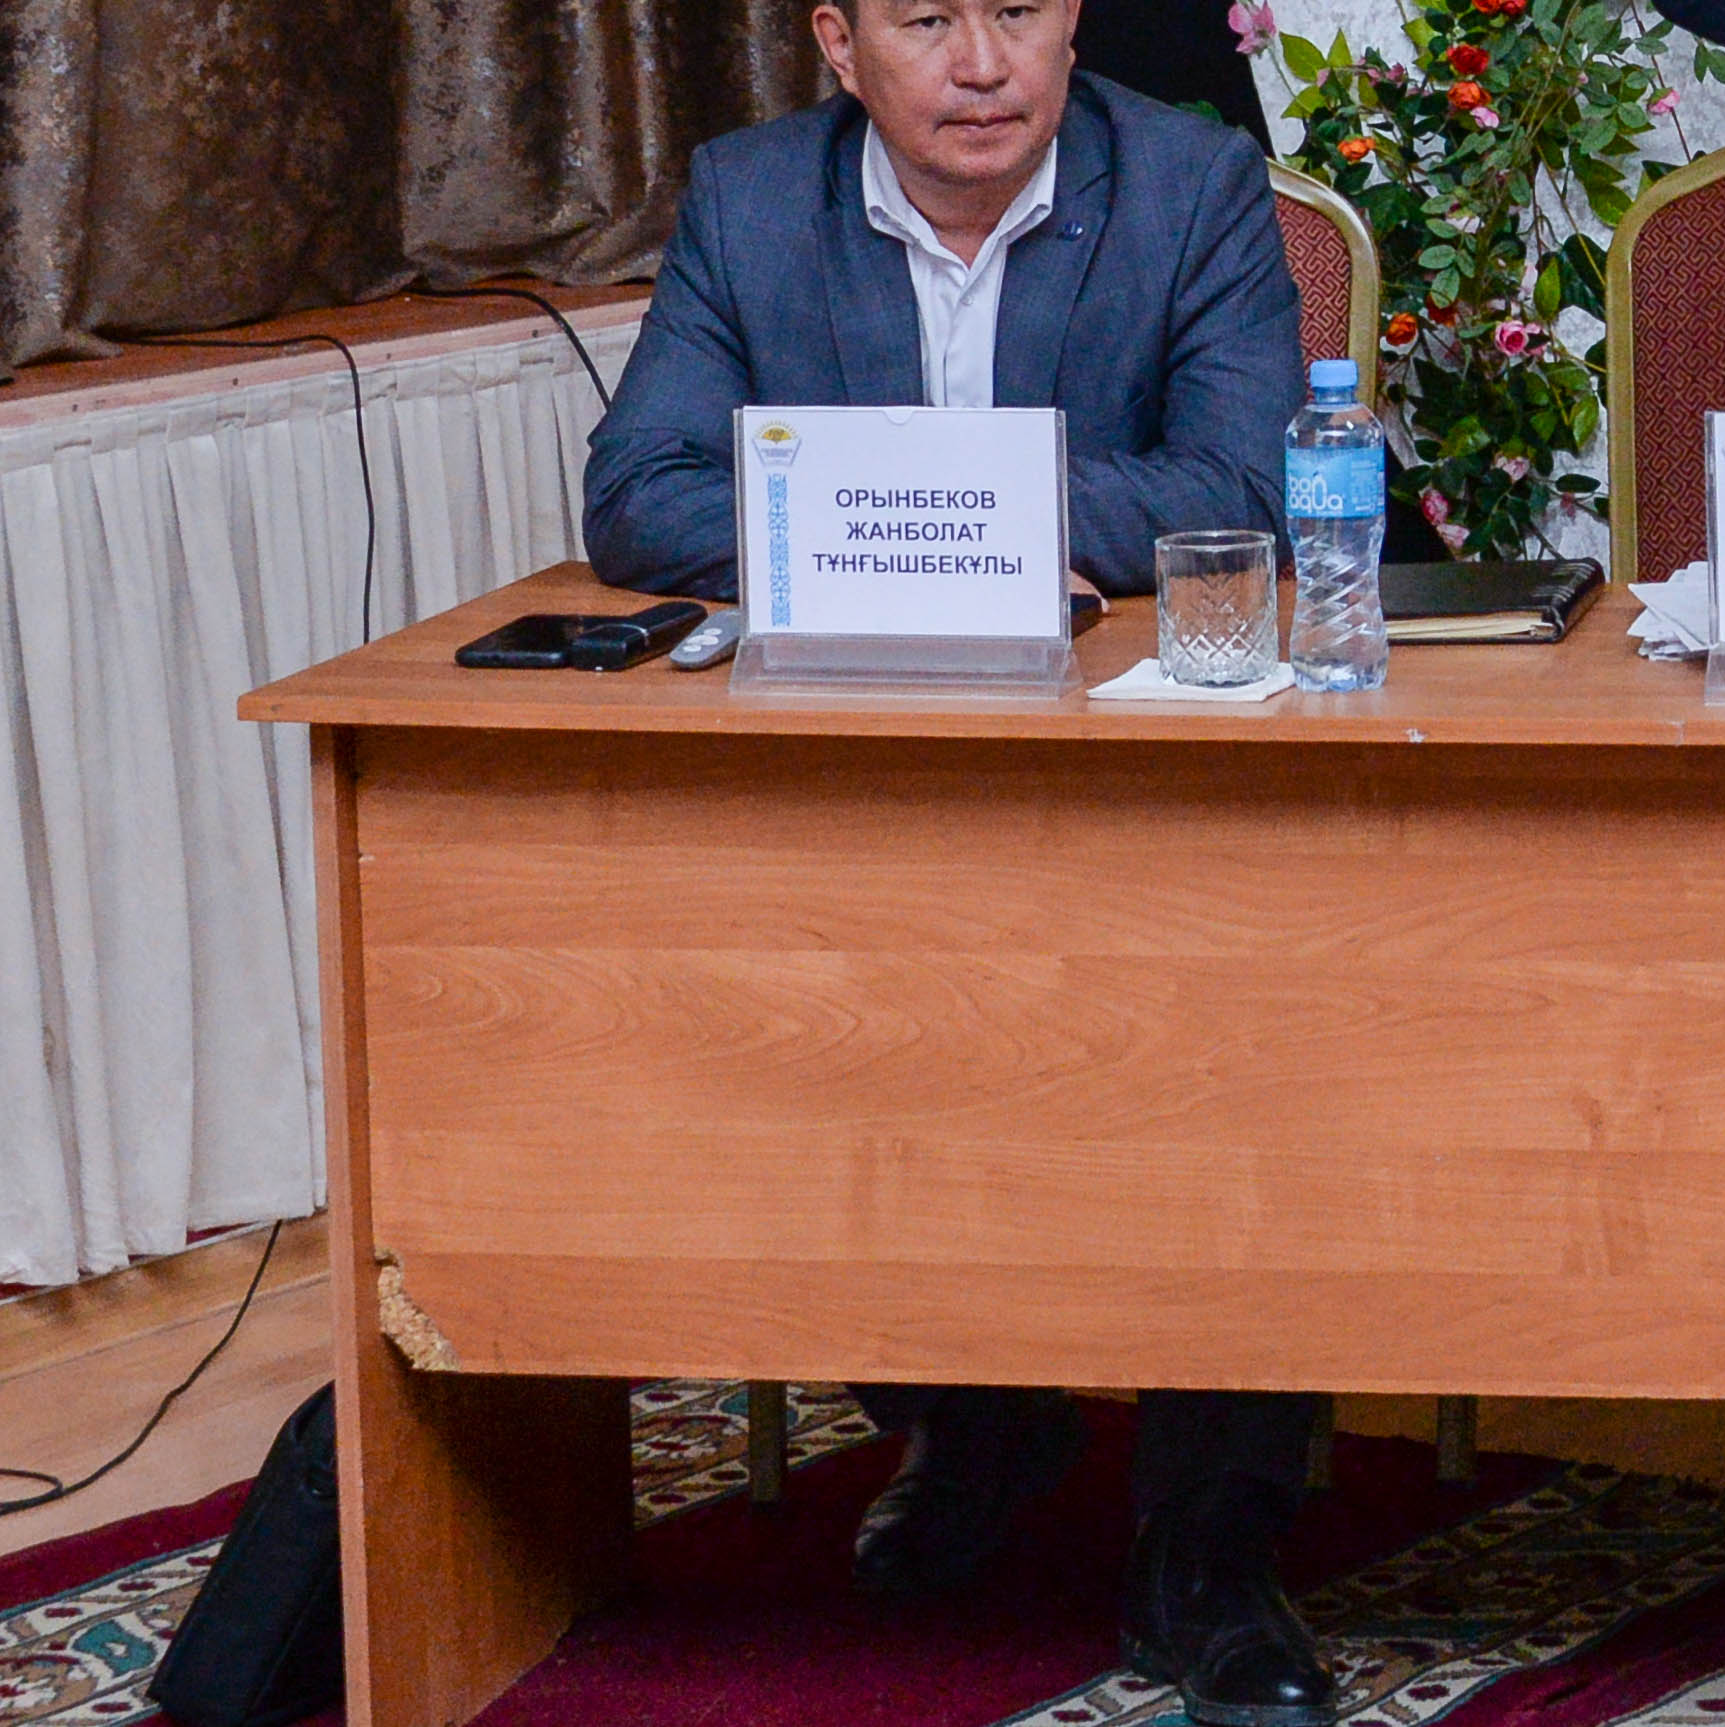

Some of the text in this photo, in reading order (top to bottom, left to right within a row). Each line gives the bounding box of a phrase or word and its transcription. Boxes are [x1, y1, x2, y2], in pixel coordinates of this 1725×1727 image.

[835, 488, 997, 510] ОРЫНБЕКОВ
[845, 521, 988, 542] ЖАНБОЛАТ
[811, 553, 1022, 575] ТҰНҒЫШБЕКҰЛЫ
